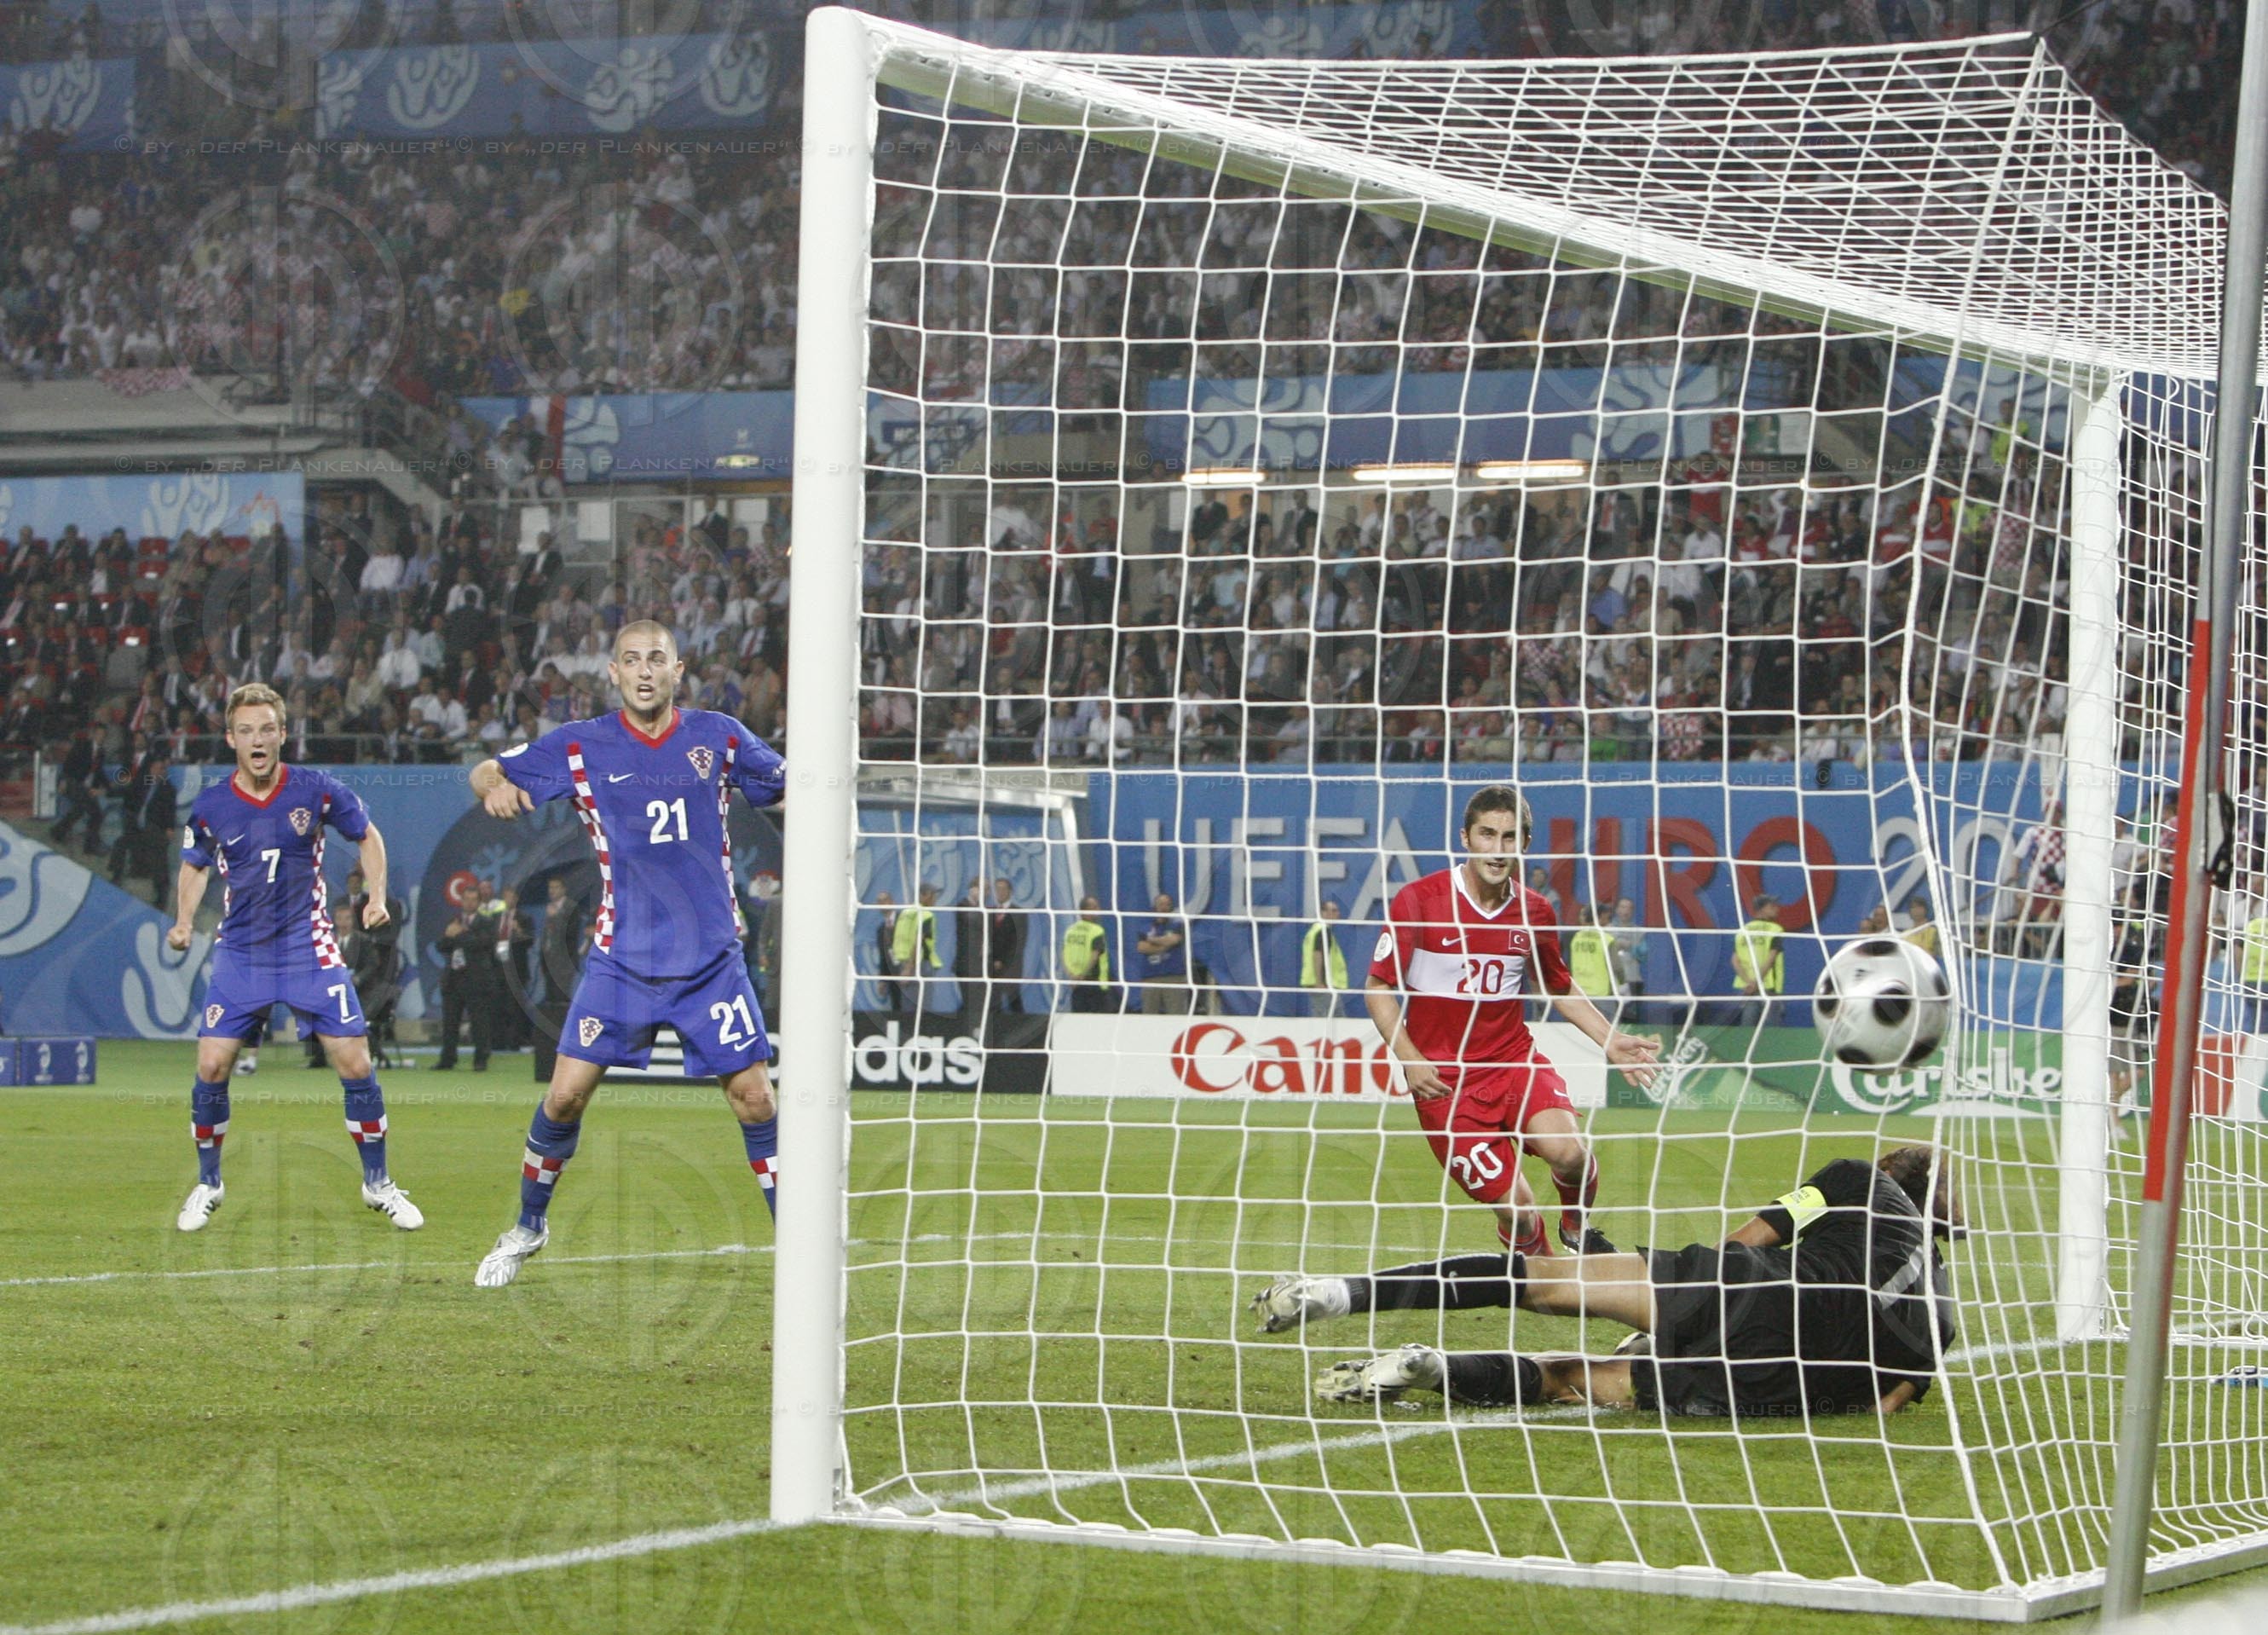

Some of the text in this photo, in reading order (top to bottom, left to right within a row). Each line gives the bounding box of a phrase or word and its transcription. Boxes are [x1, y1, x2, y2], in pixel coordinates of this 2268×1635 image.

[646, 797, 689, 844] 21
[261, 847, 281, 884] 7
[1144, 817, 1423, 923] UEFA
[1549, 816, 1837, 933] URO
[327, 983, 349, 1018] 7
[1457, 958, 1504, 995] 20
[709, 994, 757, 1045] 21
[1831, 1045, 2062, 1114] Carlsbe
[1451, 1141, 1503, 1190] 20
